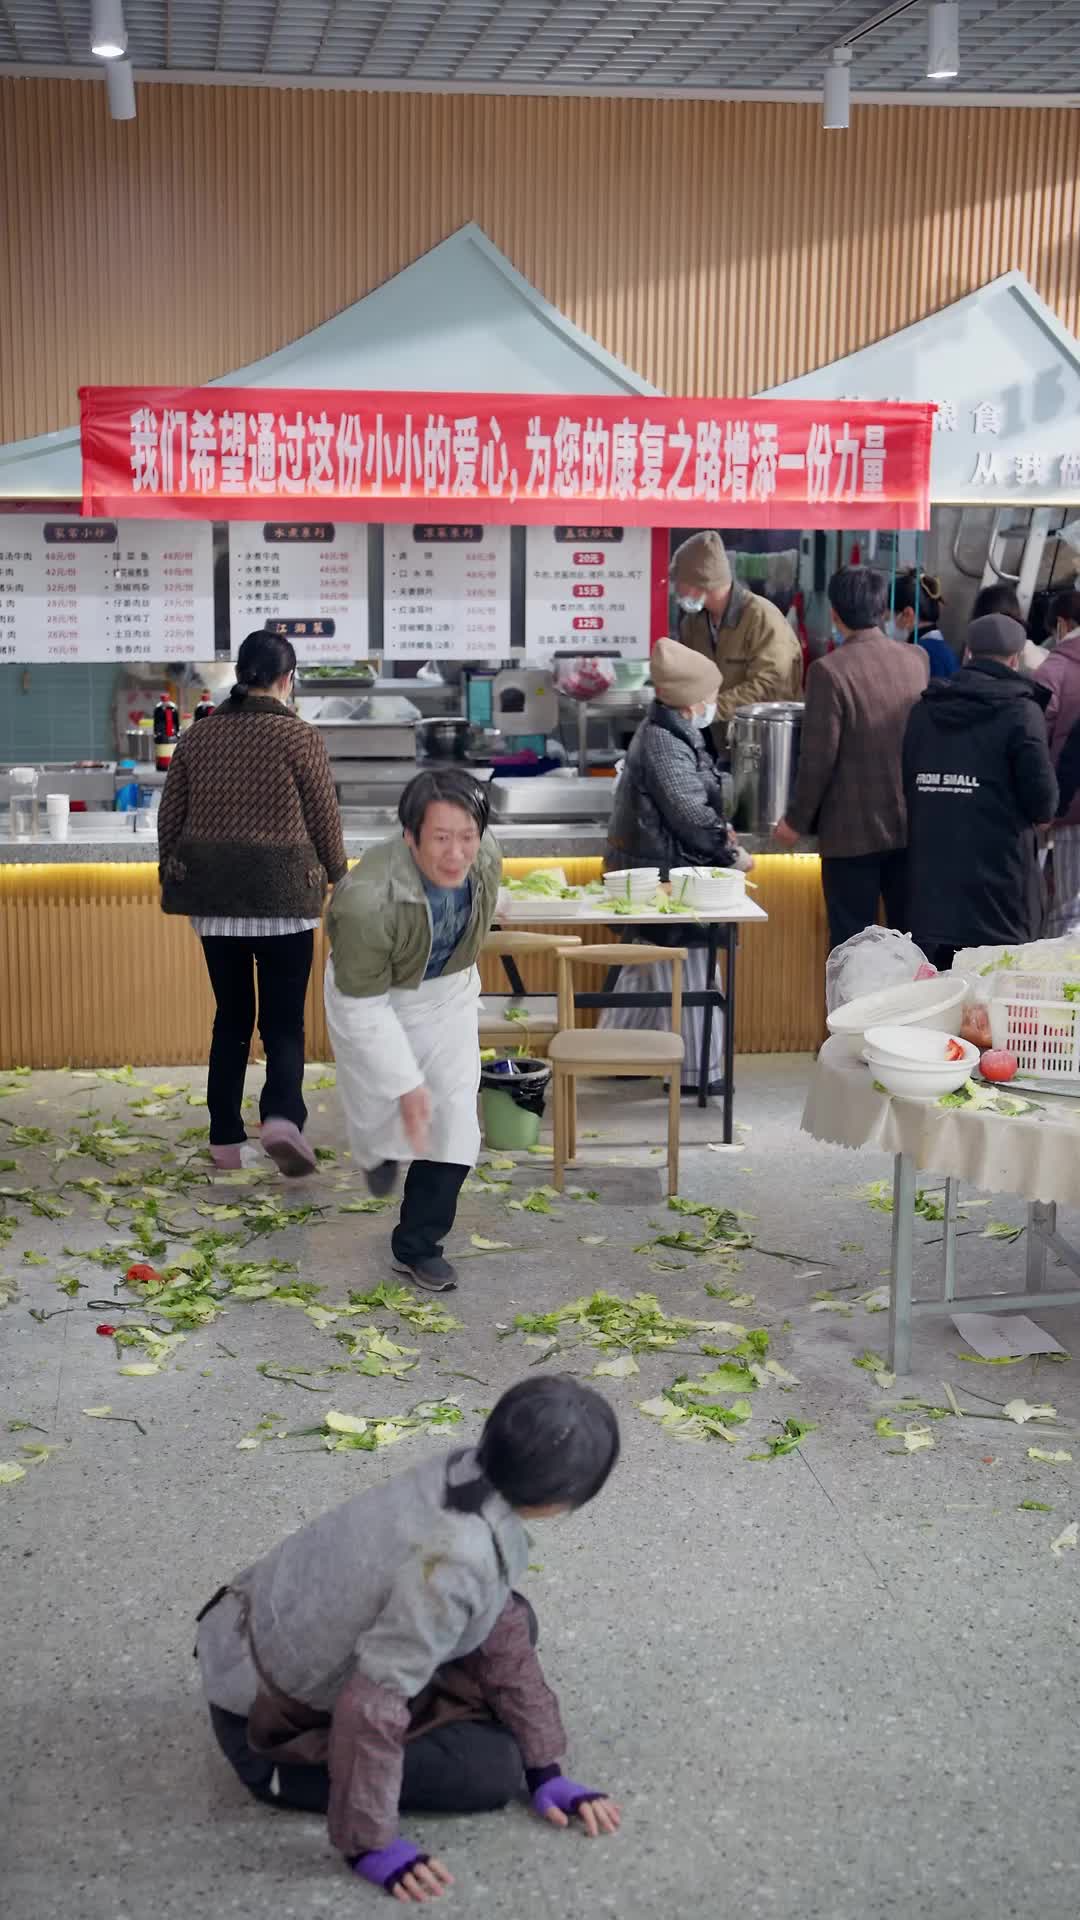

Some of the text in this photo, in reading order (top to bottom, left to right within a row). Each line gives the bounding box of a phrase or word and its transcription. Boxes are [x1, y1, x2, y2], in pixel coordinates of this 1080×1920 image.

[130, 408, 888, 504] 我们希望通过这份小小的爱心，为您的康复之路增添一份力量
[578, 554, 600, 564] 20元
[578, 587, 600, 596] 15元
[578, 619, 599, 629] 12元
[916, 773, 980, 787] FROM SMALL
